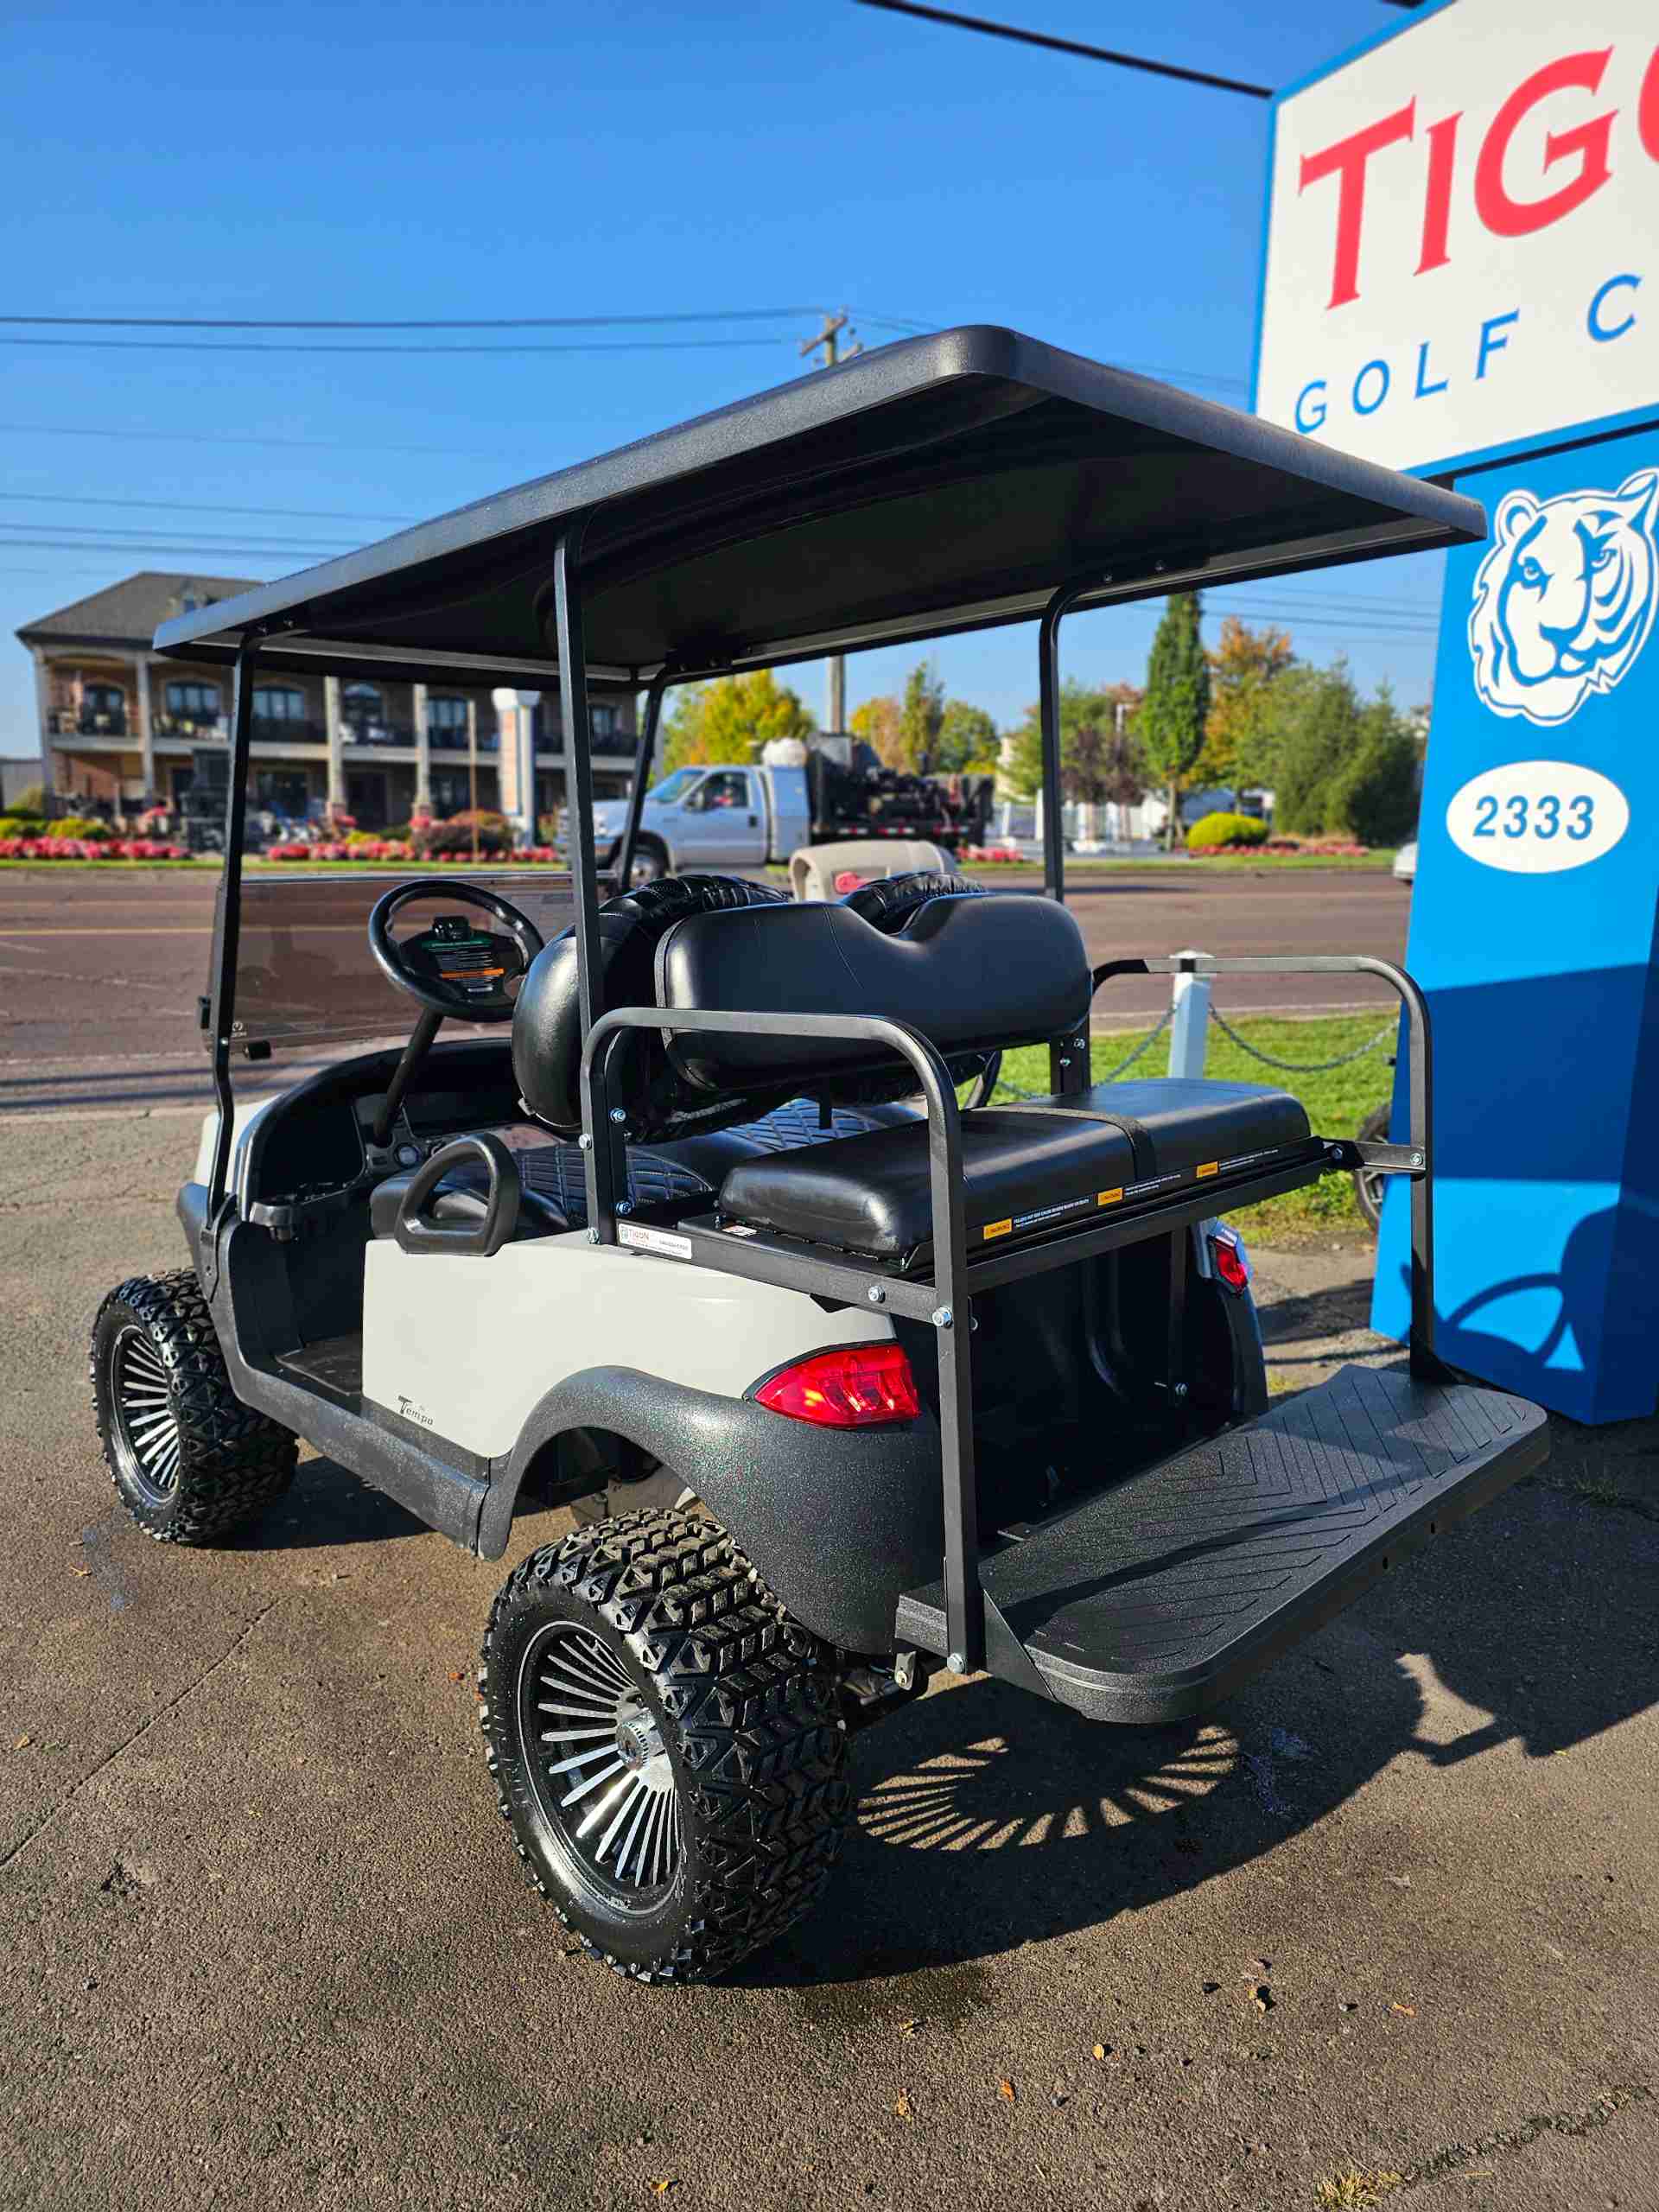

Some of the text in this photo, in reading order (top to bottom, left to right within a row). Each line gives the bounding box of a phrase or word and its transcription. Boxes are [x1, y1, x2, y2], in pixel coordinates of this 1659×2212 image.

[1299, 43, 1659, 310] TIG
[1295, 308, 1520, 434] GOLF
[1472, 795, 1594, 841] 2333
[398, 1395, 434, 1426] Tempo
